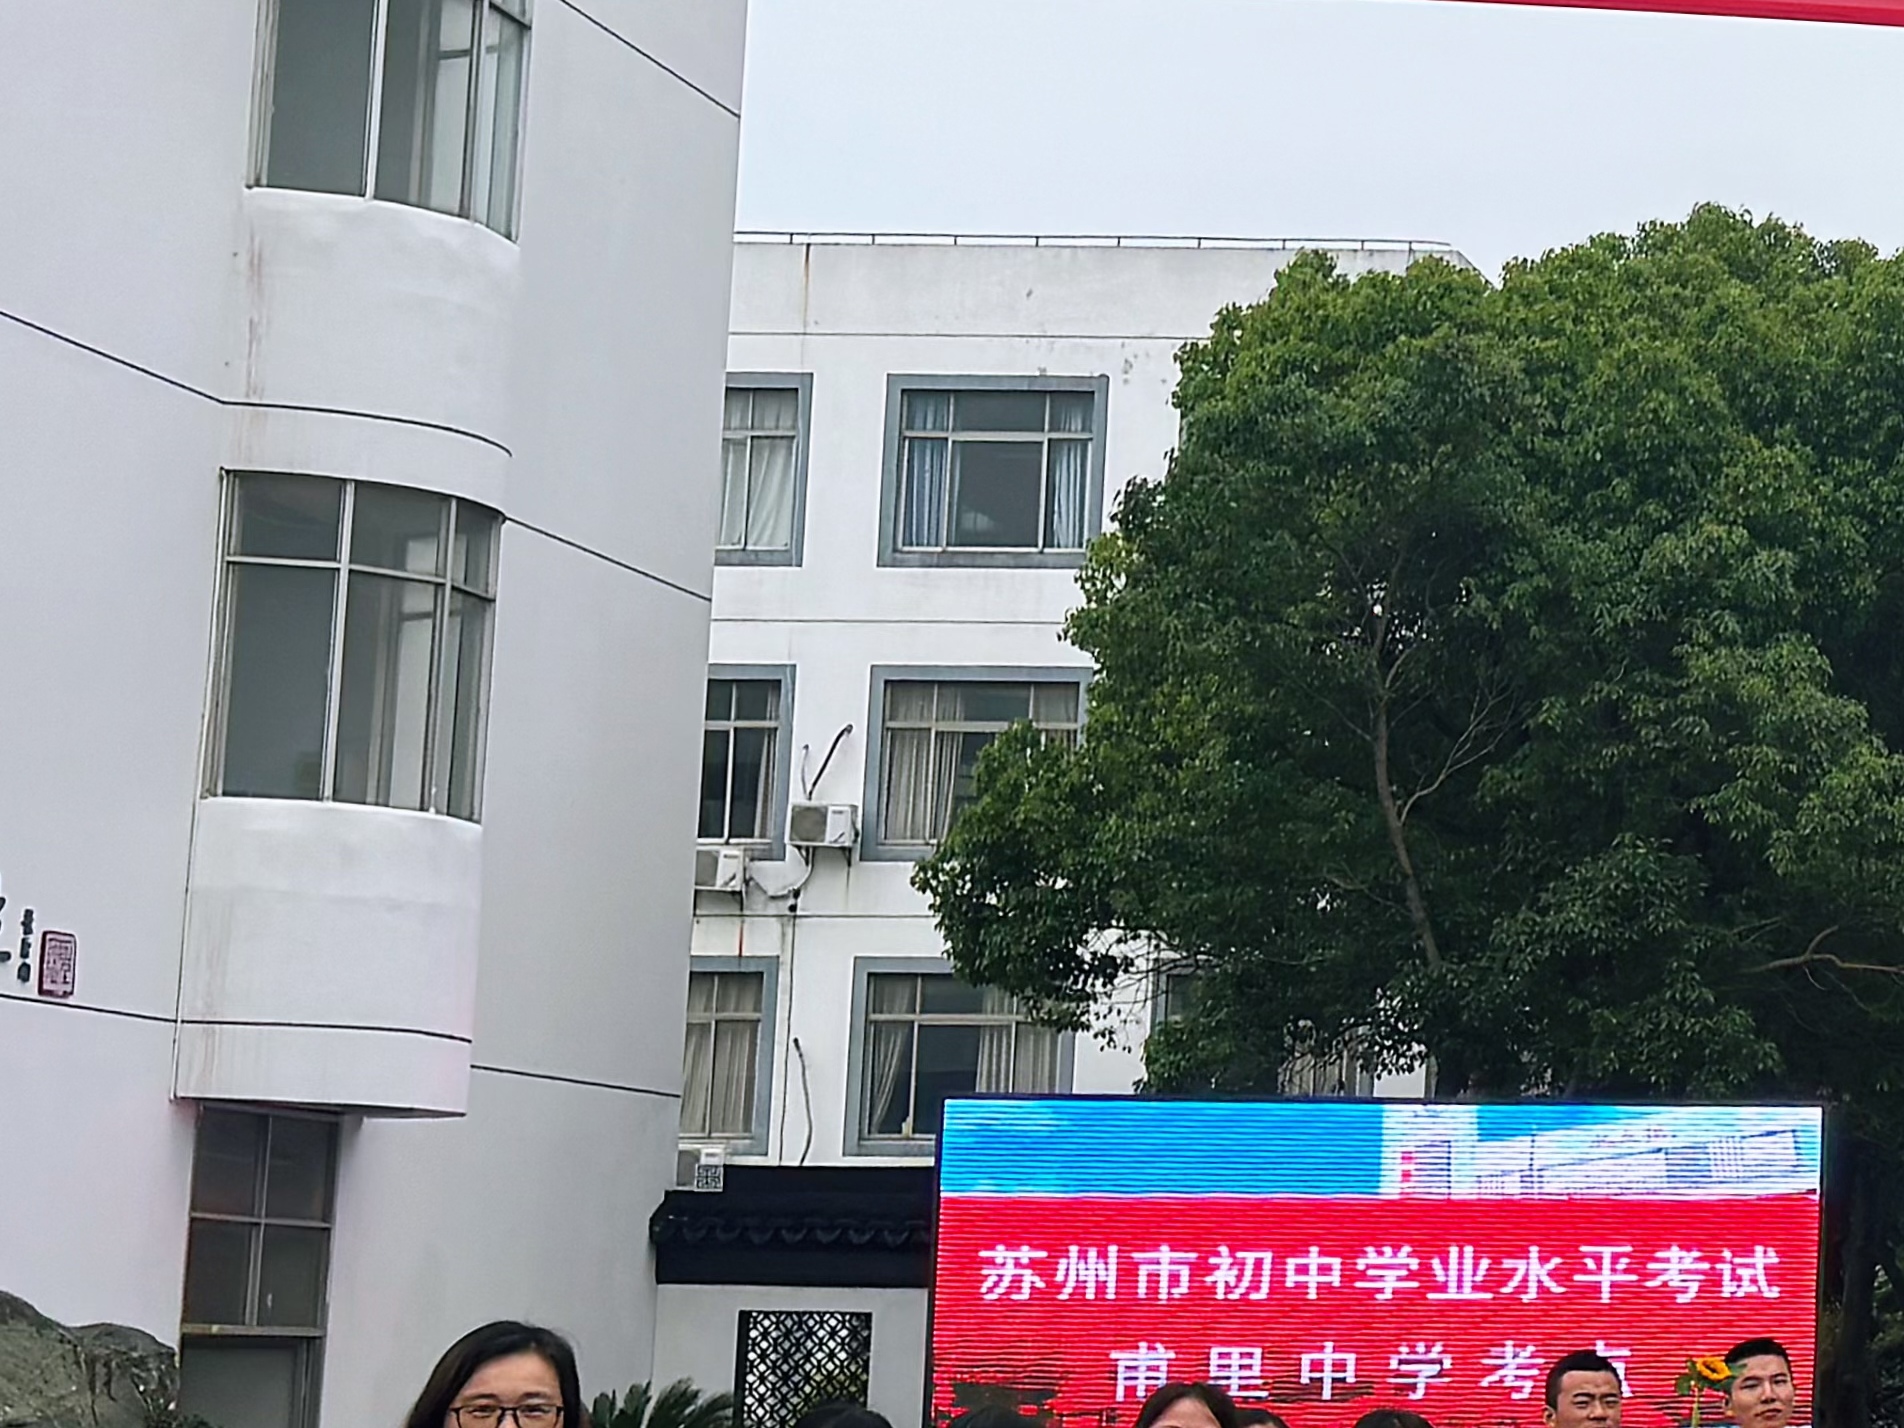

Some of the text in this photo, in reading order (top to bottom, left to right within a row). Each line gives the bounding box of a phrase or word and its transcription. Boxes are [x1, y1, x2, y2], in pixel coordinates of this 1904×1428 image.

[977, 1243, 1782, 1303] 苏州市初中学业水平考试
